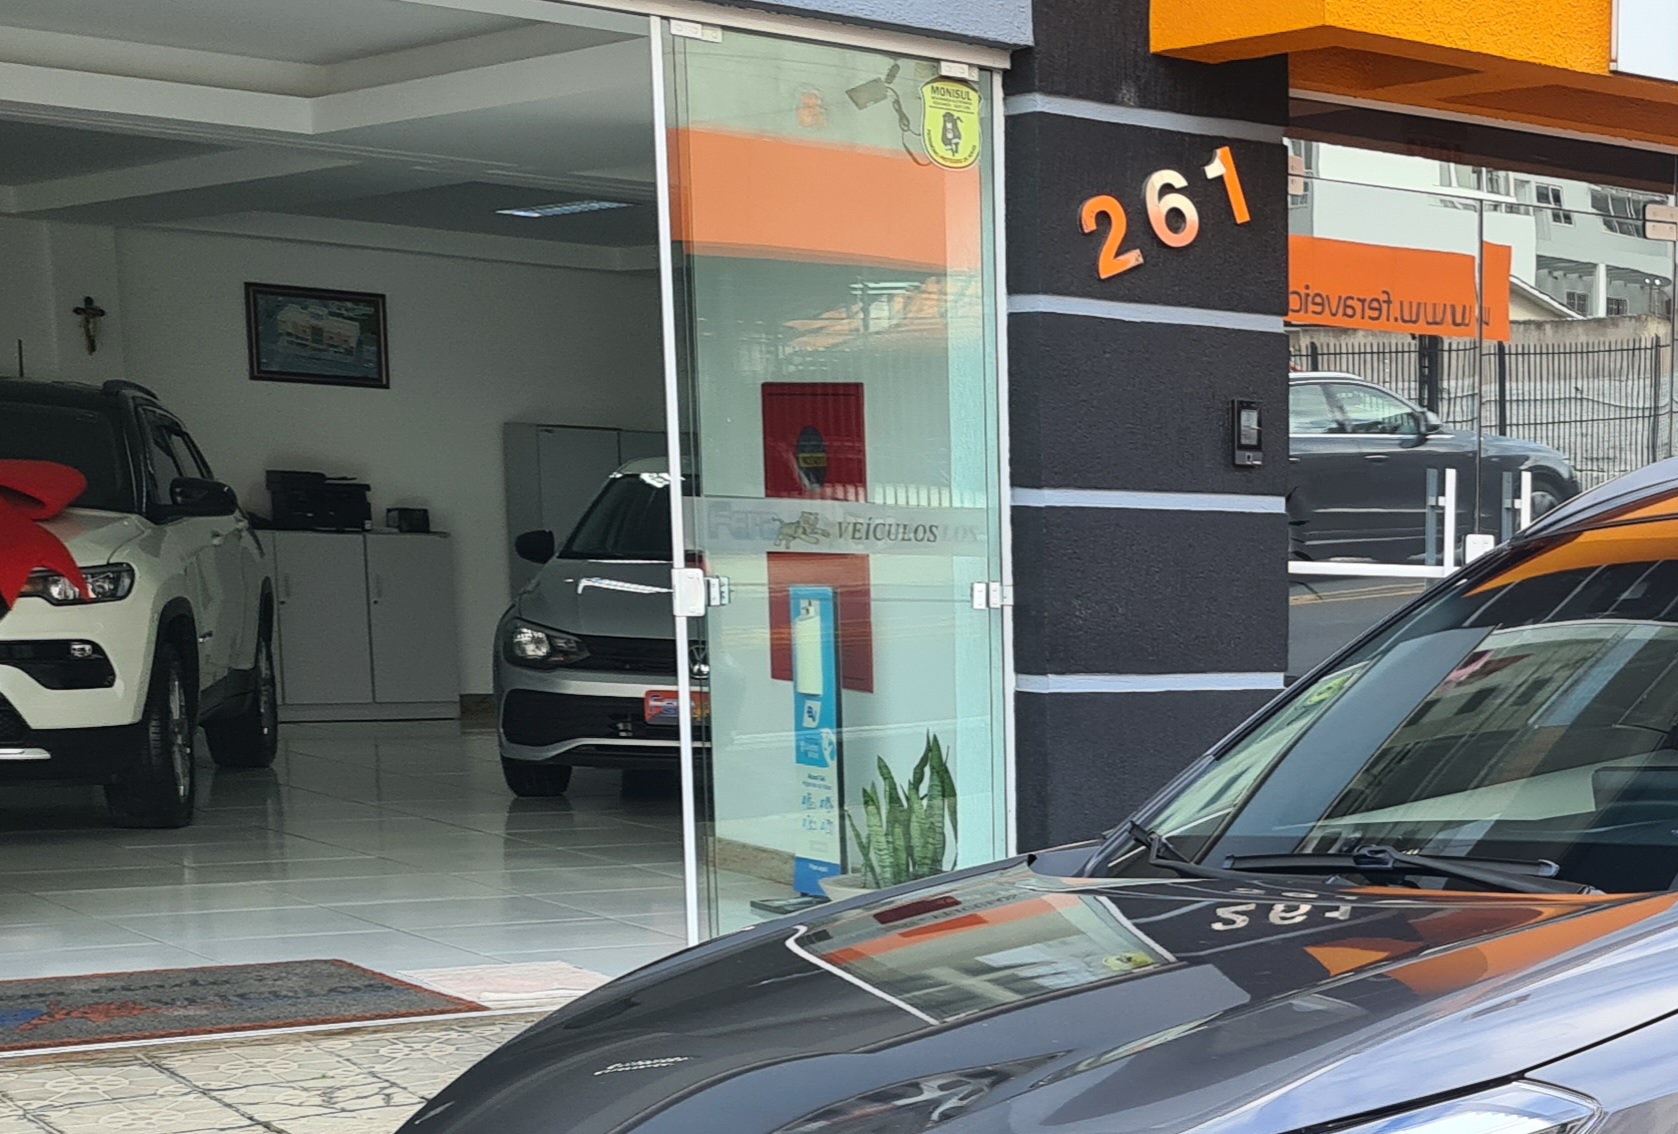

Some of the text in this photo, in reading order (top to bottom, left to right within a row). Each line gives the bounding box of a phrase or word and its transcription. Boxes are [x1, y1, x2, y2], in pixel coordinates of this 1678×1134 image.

[930, 84, 973, 102] MONISUL
[1080, 146, 1251, 280] 261
[836, 517, 939, 543] VEÍCULOS
